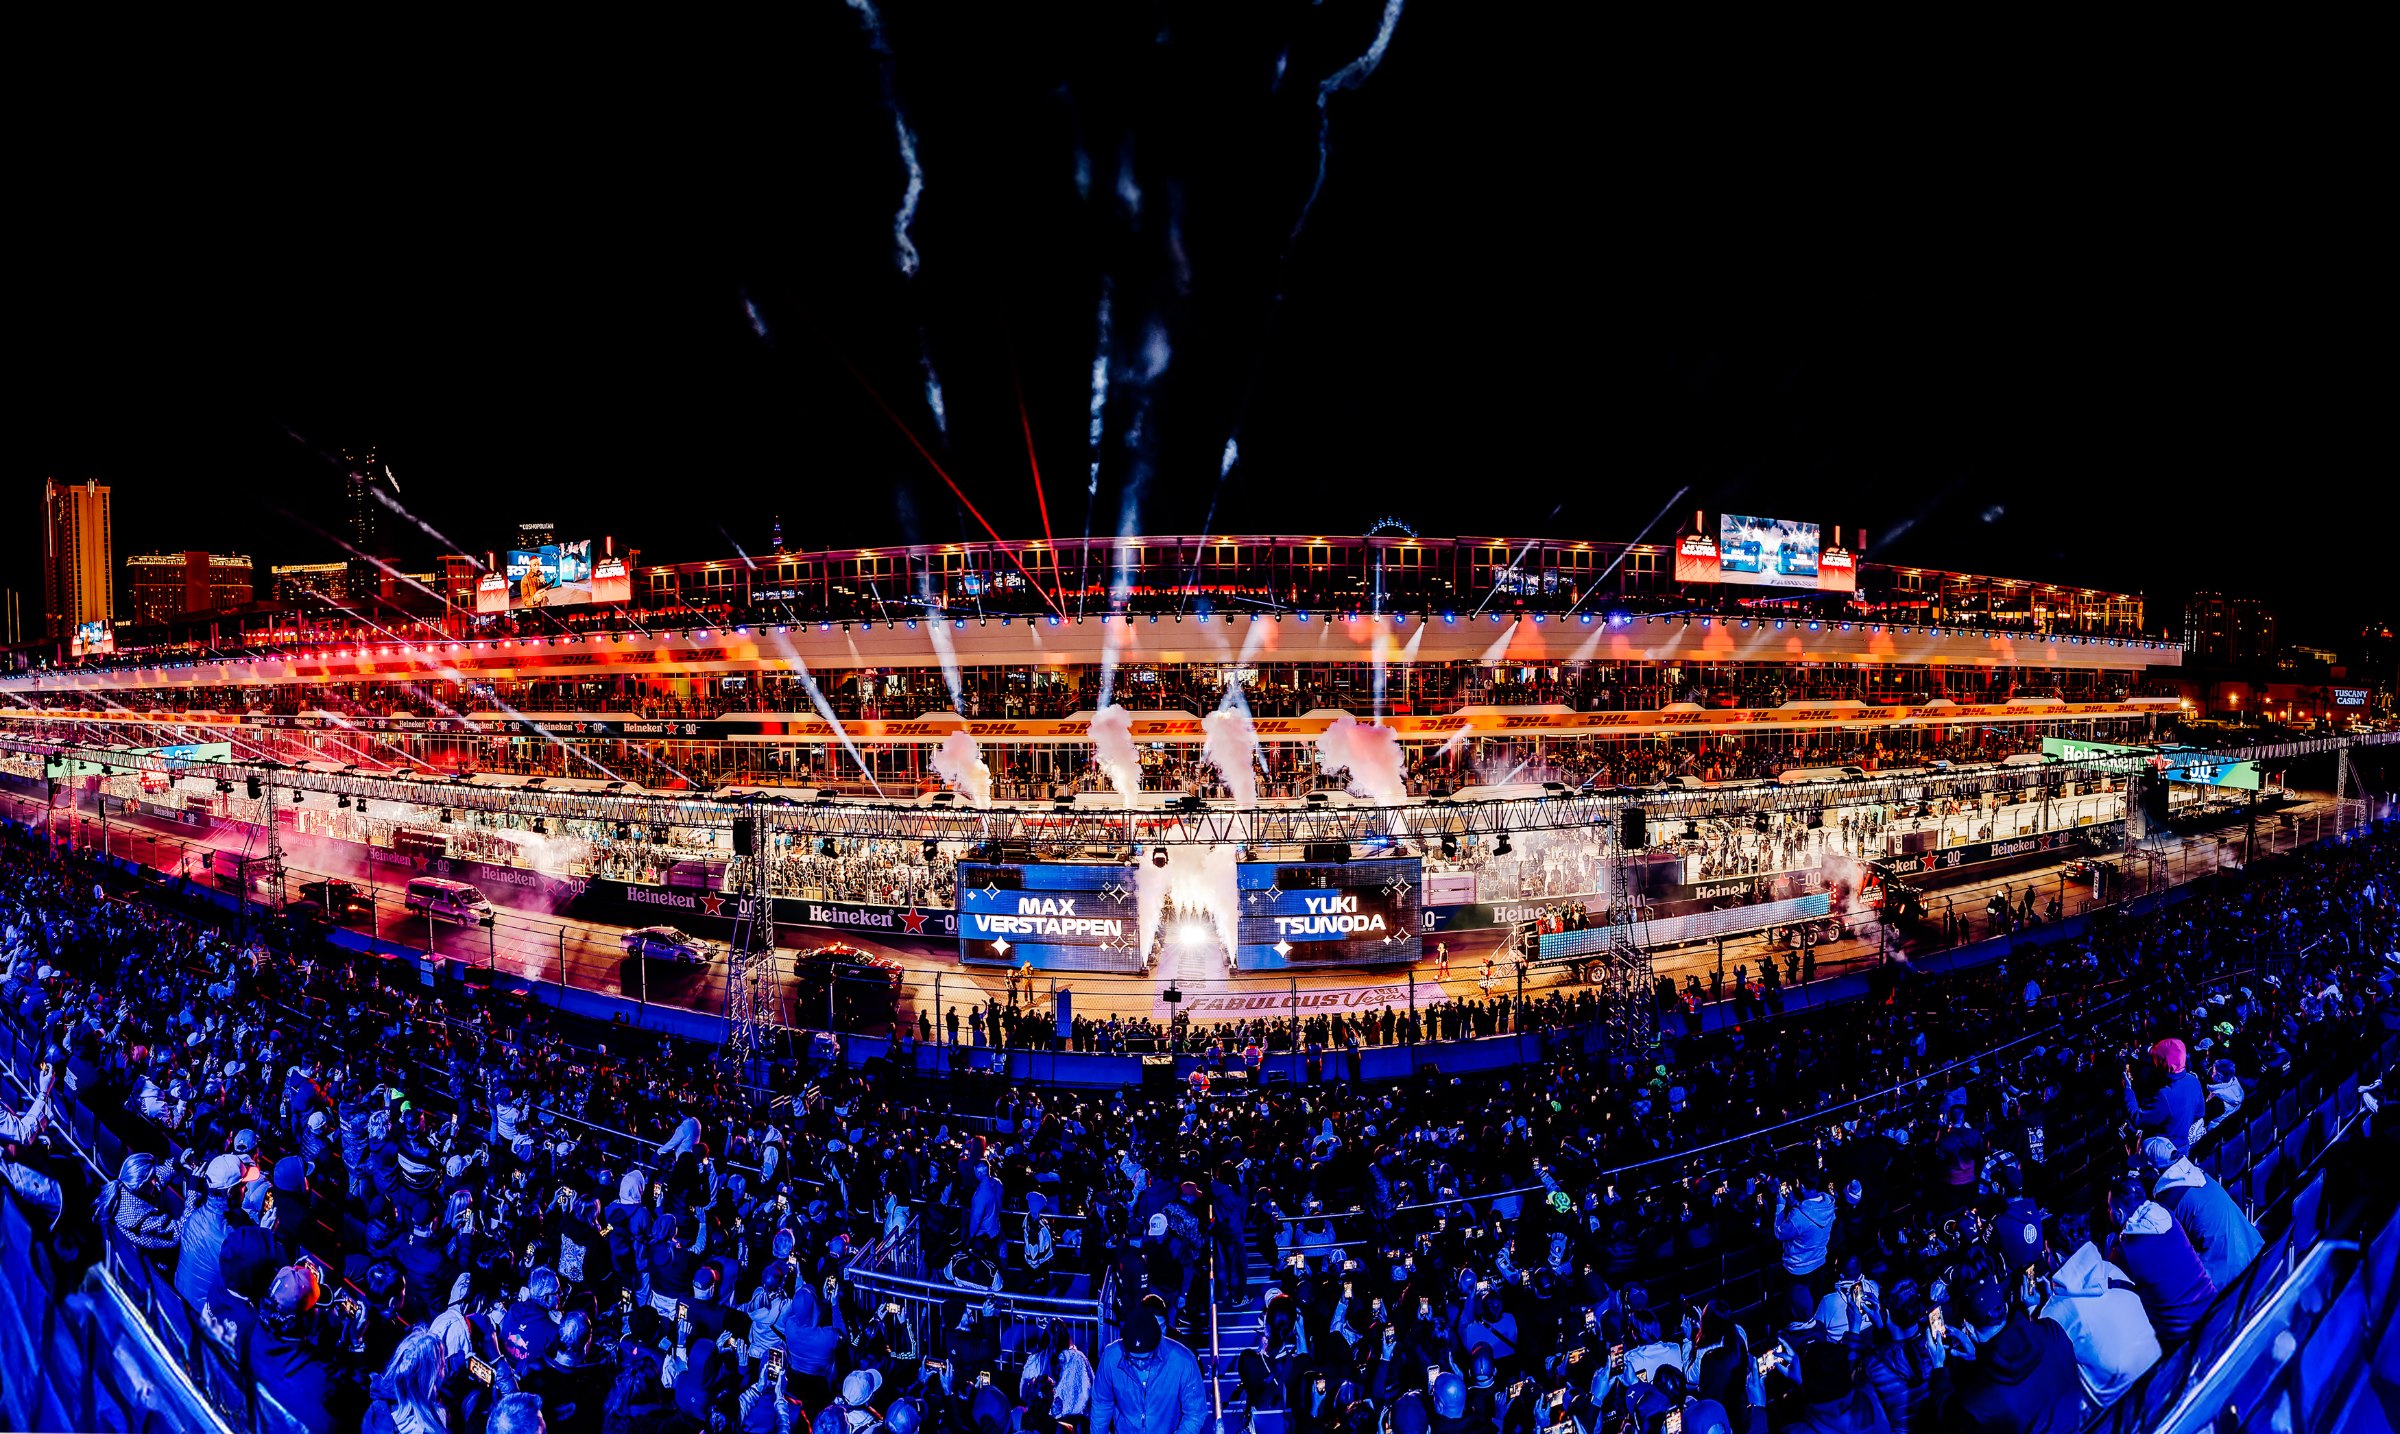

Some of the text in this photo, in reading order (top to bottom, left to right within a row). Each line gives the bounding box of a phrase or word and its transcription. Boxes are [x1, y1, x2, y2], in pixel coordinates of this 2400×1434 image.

[561, 655, 596, 666] DHL
[621, 651, 657, 663] DHL
[685, 649, 725, 662] DHL
[2334, 689, 2368, 698] TUSCANY
[2336, 697, 2365, 705] CASINO
[1798, 710, 1832, 720] DHL
[1856, 709, 1889, 719] DHL
[1911, 708, 1941, 717] DHL
[1961, 707, 1987, 716] DHL
[2006, 706, 2030, 715] DHL
[2047, 706, 2070, 714] DHL
[1506, 716, 1552, 728] DHL
[1587, 714, 1631, 726] DHL
[1662, 713, 1702, 725] DHL
[1733, 711, 1770, 722] DHL
[400, 720, 426, 729] Heineken
[464, 721, 495, 730] Heineken
[538, 722, 573, 731] Heineken
[624, 722, 663, 732] Heineken
[885, 723, 933, 735] DHL
[970, 723, 1020, 735] DHL
[1058, 723, 1091, 734] DH
[1148, 722, 1202, 734] DHL
[1990, 839, 2036, 857] Heineken
[482, 866, 537, 887] Heineken
[626, 886, 696, 909] Heineken
[1018, 897, 1075, 916] MAX
[1304, 896, 1358, 914] YUKI
[808, 905, 894, 927] Heineken
[974, 915, 1122, 937] VERSTAPPEN
[1274, 914, 1387, 935] TSUNODA
[1190, 988, 1409, 1011] FABULOUS Vegas
